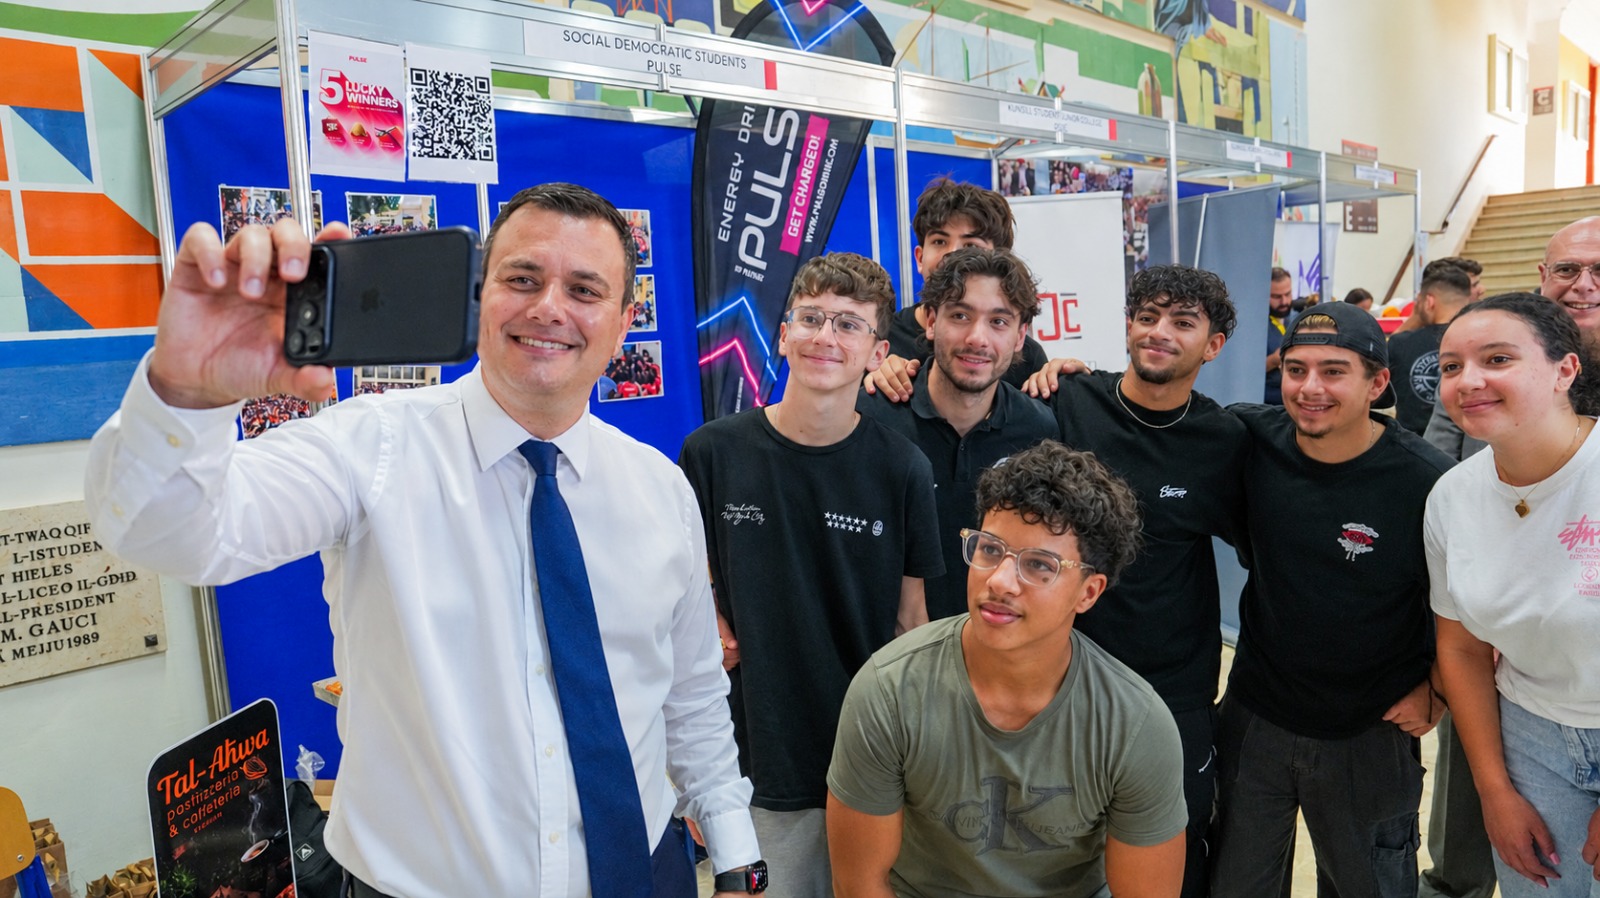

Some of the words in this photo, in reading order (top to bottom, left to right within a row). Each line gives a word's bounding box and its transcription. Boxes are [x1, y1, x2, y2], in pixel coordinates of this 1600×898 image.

[348, 55, 368, 63] PULSE
[563, 30, 611, 49] SOCIAL
[614, 37, 692, 60] DEMOCRATIC
[695, 51, 747, 70] STUDENTS
[647, 60, 682, 76] PULSE
[319, 68, 344, 105] 5
[345, 80, 385, 97] LUCKY
[346, 91, 399, 108] WINNERS
[795, 134, 821, 207] CHARGED!
[718, 152, 745, 242] ENERGY
[738, 107, 800, 271] PULS
[788, 208, 803, 237] GET
[0, 523, 91, 546] T-TWAQQIF
[29, 612, 97, 637] GAUCI
[169, 824, 180, 838] &
